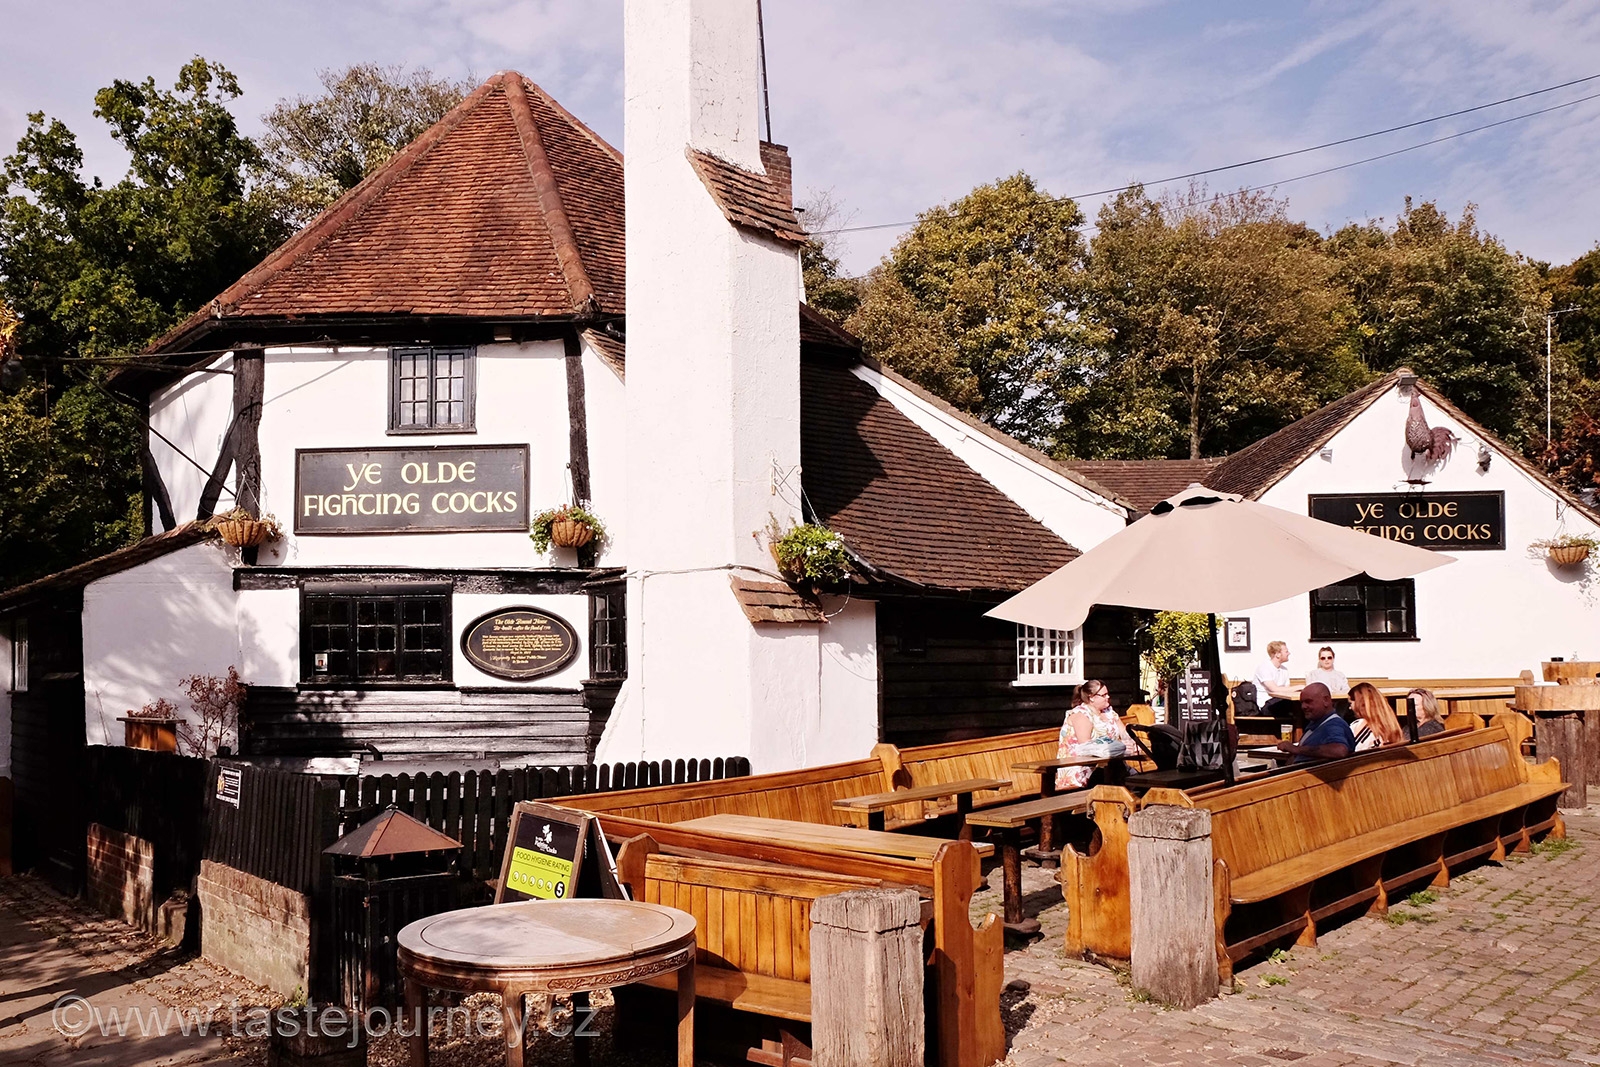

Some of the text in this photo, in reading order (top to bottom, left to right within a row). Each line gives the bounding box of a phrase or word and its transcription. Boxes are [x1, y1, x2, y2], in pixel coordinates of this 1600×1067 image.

[343, 461, 476, 491] YE OLDE
[303, 491, 517, 517] FIGHTING COCKS
[1353, 501, 1458, 524] YE OLDE
[1423, 523, 1492, 540] COCKS
[516, 851, 570, 872] FOOD HYGIENE RATING
[556, 882, 564, 897] 5
